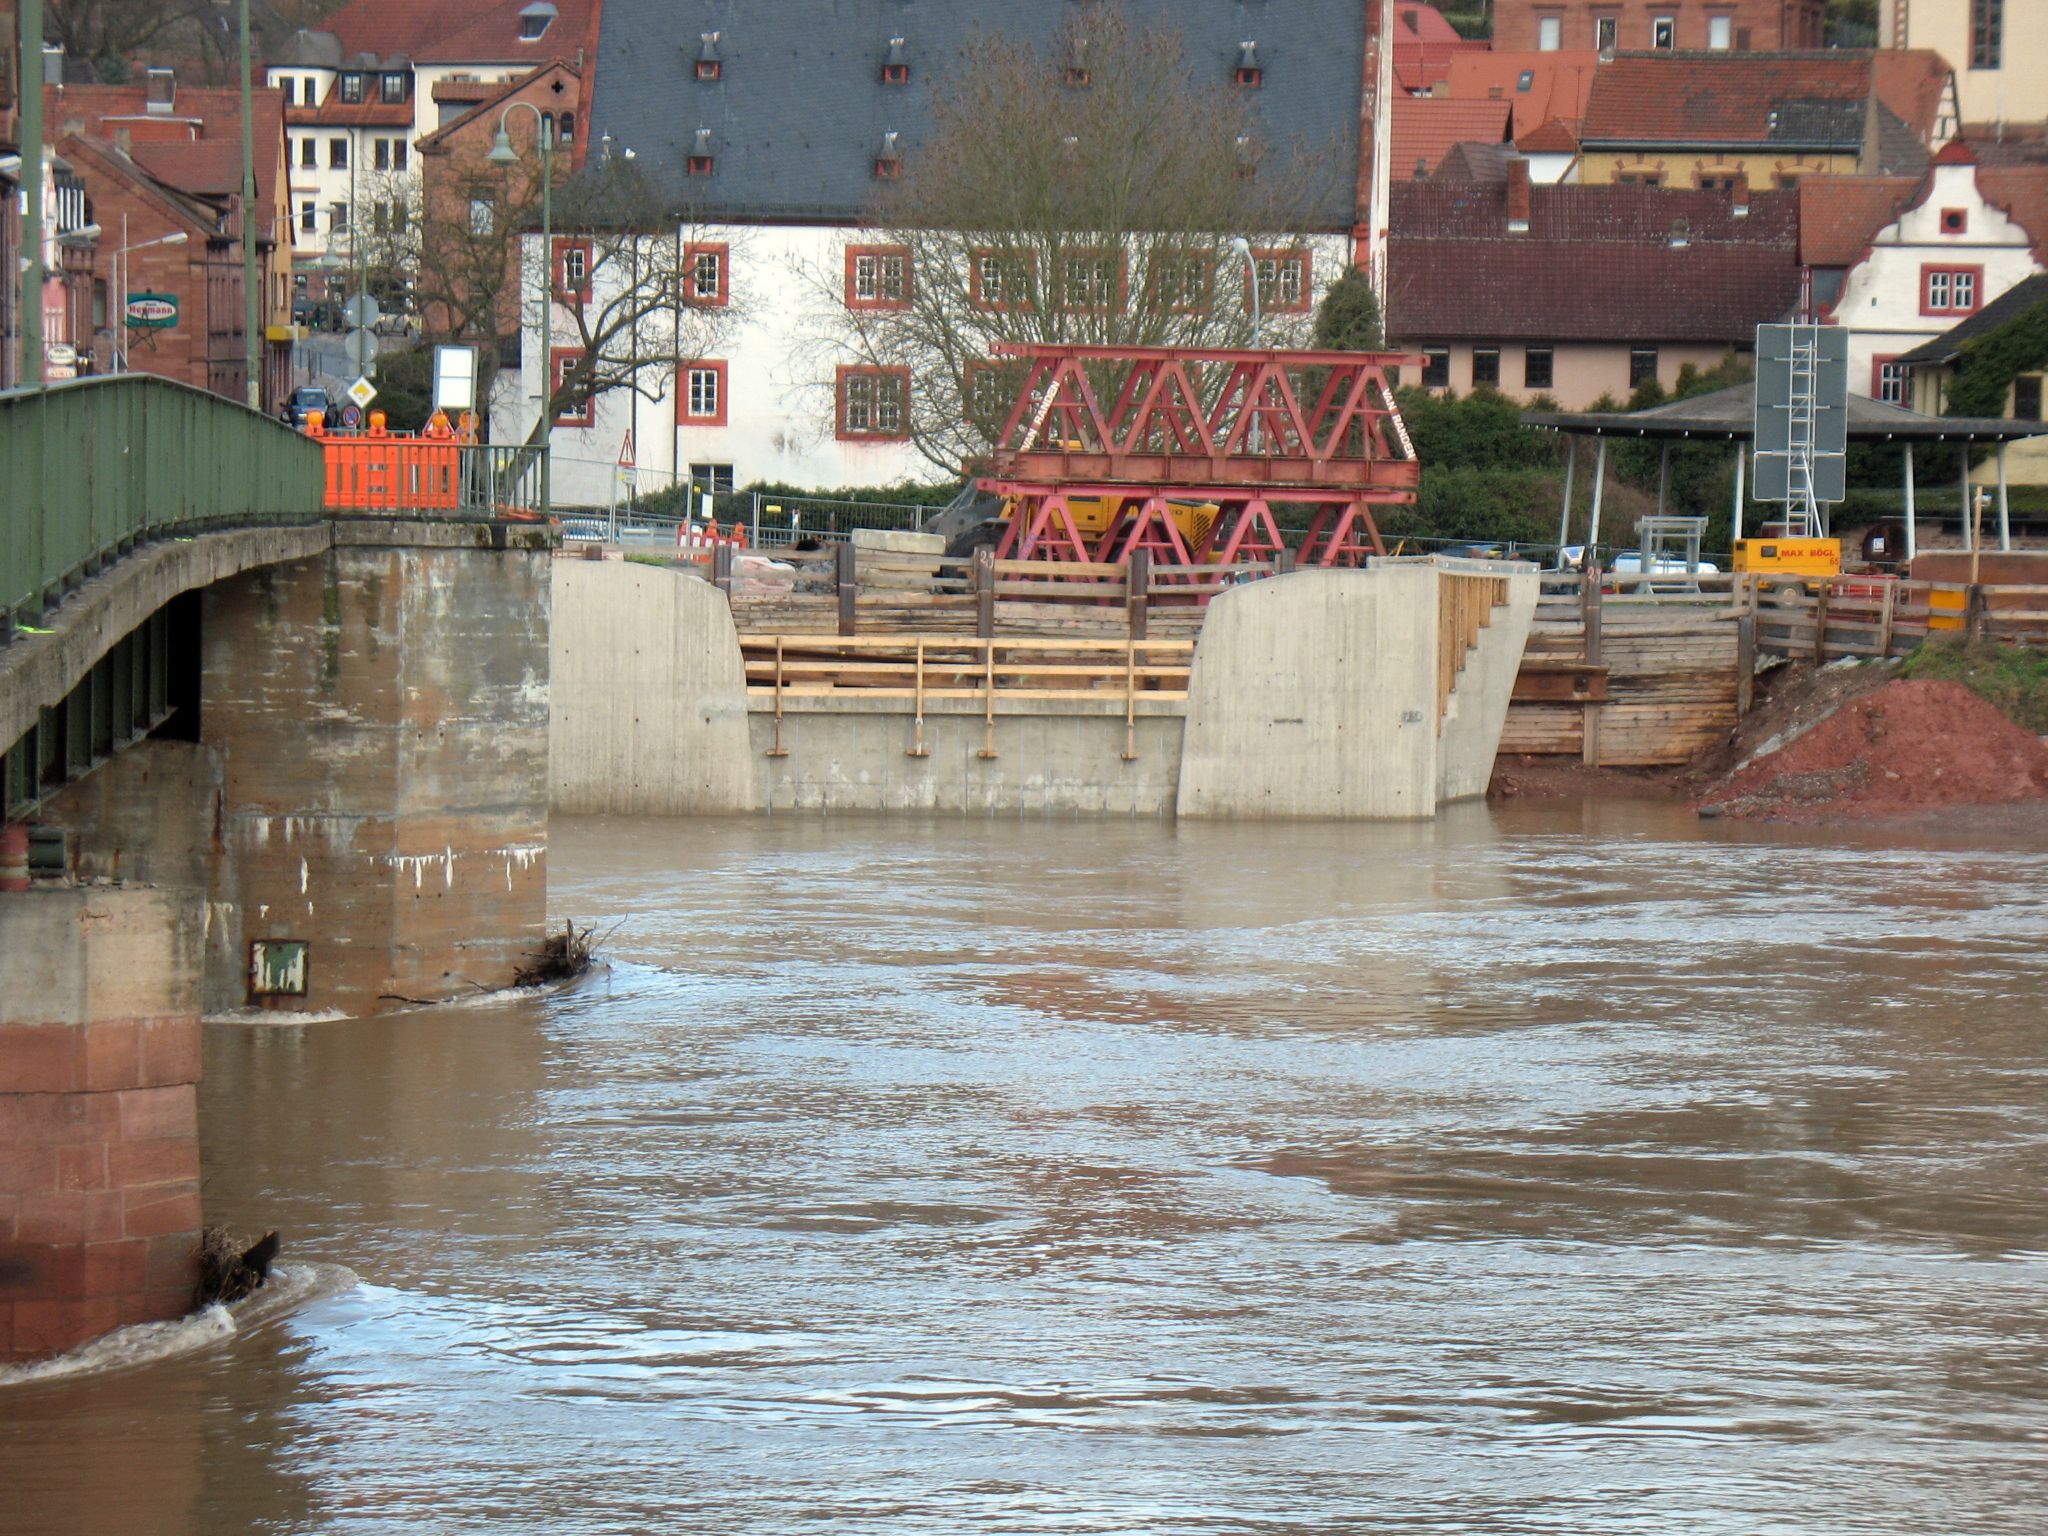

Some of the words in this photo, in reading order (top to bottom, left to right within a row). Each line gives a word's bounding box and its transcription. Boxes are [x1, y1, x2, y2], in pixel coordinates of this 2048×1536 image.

[1021, 428, 1038, 451] VAN
[1034, 380, 1060, 424] RANDEN
[1383, 388, 1397, 411] VAN
[1392, 414, 1416, 459] RANDEN
